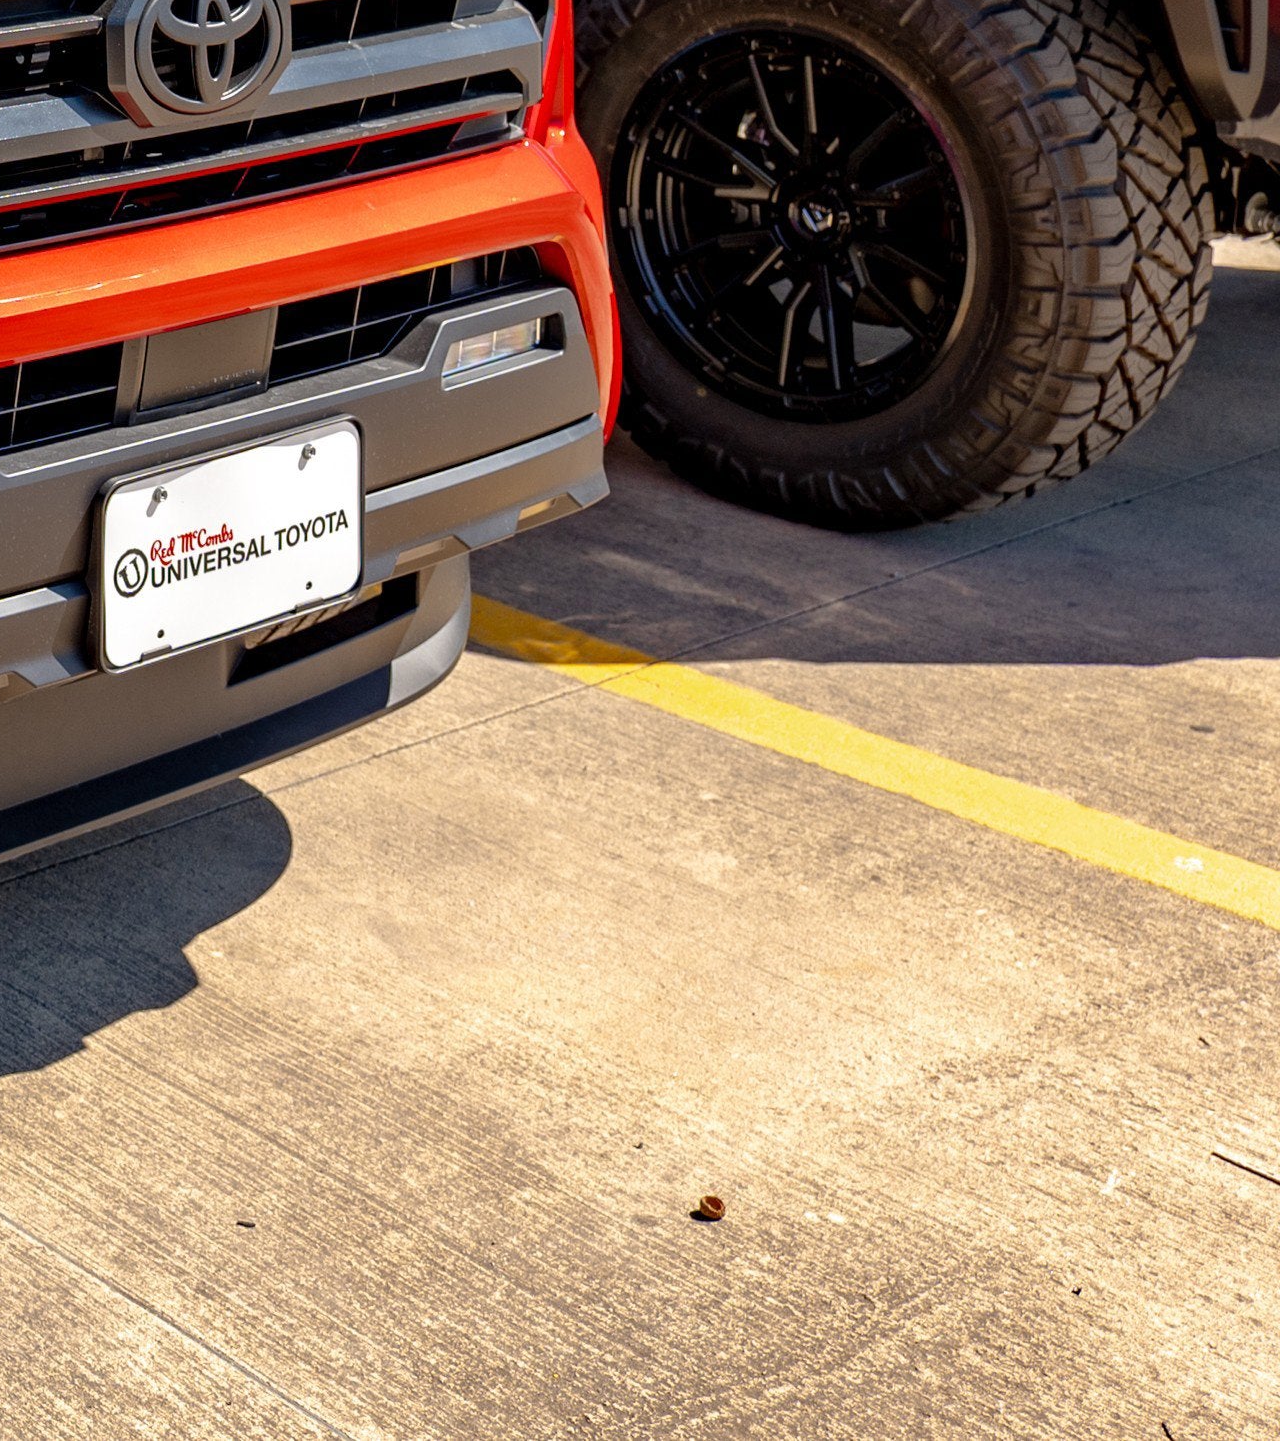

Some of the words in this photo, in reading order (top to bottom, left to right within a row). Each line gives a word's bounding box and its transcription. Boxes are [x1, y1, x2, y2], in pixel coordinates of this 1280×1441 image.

[150, 537, 176, 566] Red
[177, 523, 234, 554] McCombs
[150, 535, 272, 588] UNIVERSAL
[275, 509, 349, 551] TOYOTA
